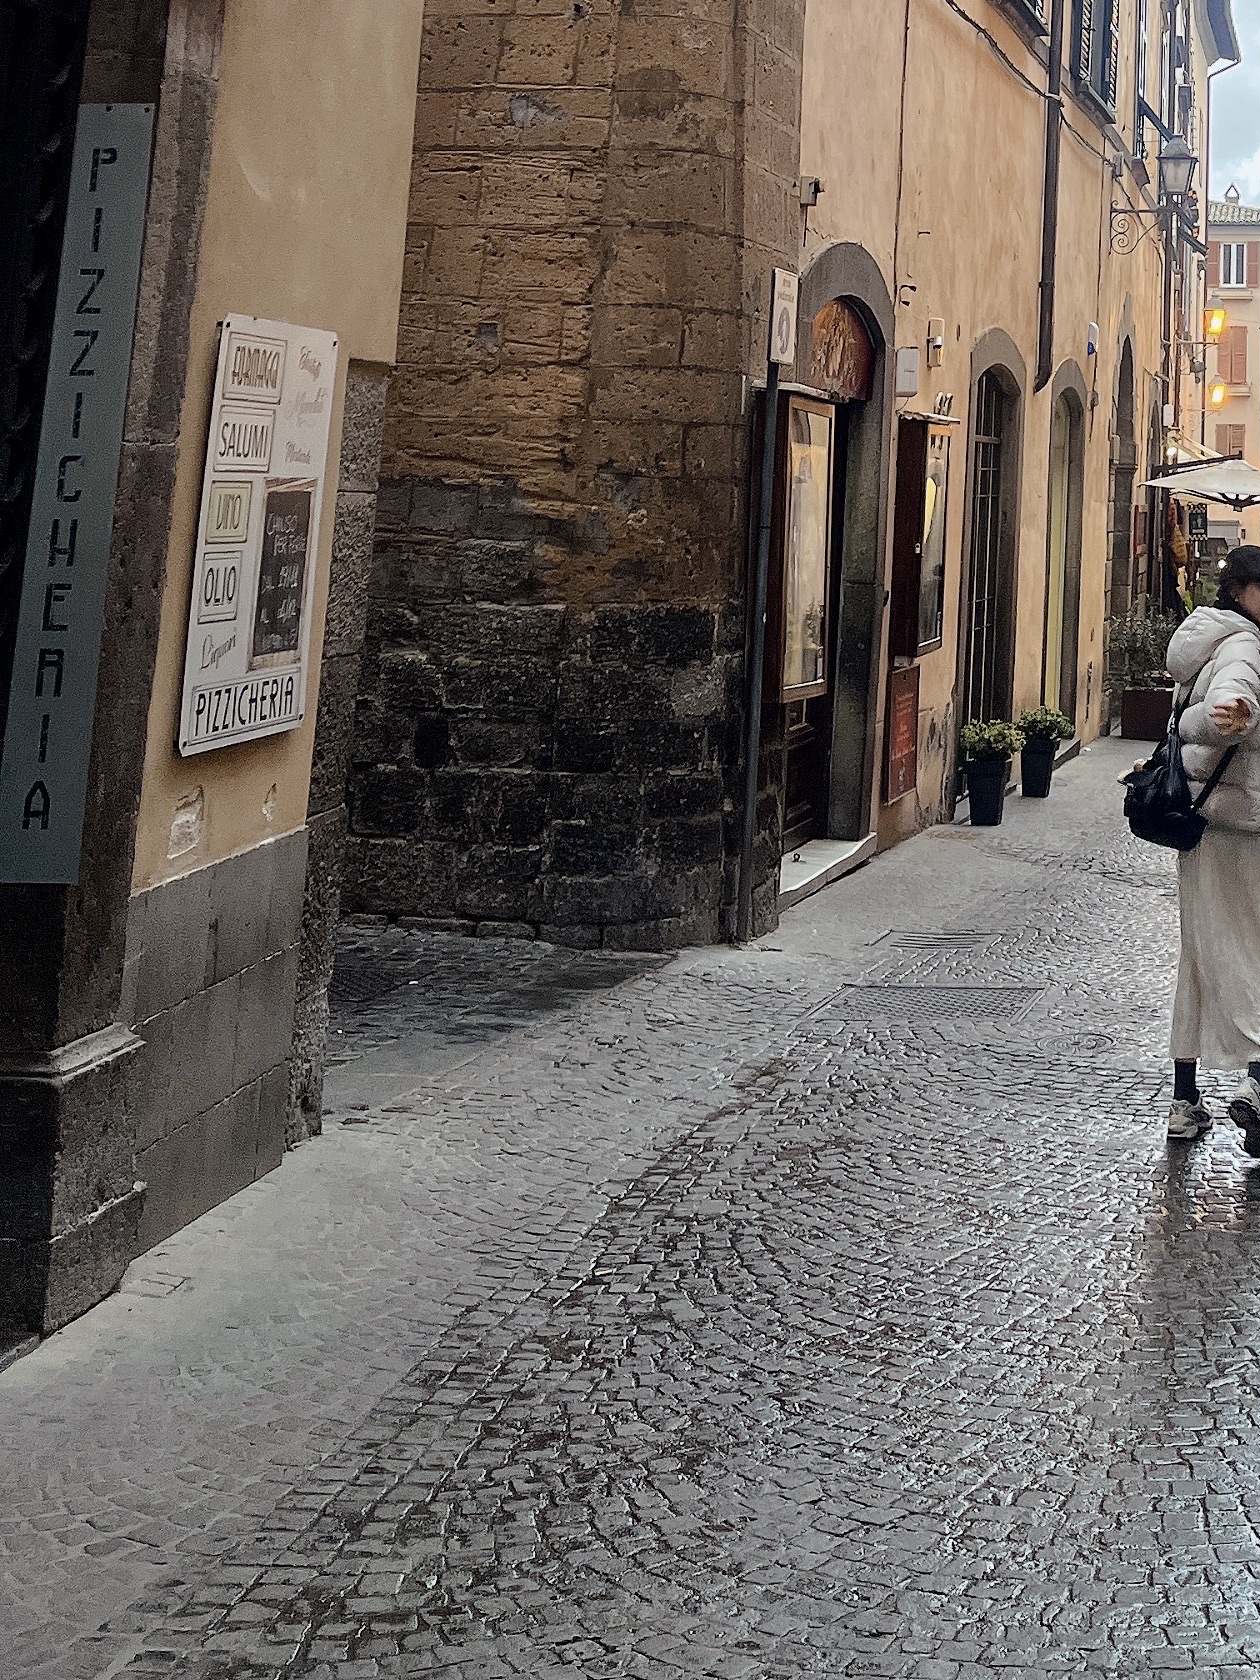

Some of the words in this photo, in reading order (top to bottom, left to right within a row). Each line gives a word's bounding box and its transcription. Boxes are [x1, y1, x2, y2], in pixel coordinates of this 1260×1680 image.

[218, 421, 269, 459] SALUMI
[21, 146, 118, 831] PIZZICHERIA
[215, 493, 242, 531] VINO
[204, 565, 237, 605] OLIO
[194, 675, 294, 737] PIZZICHERIA
